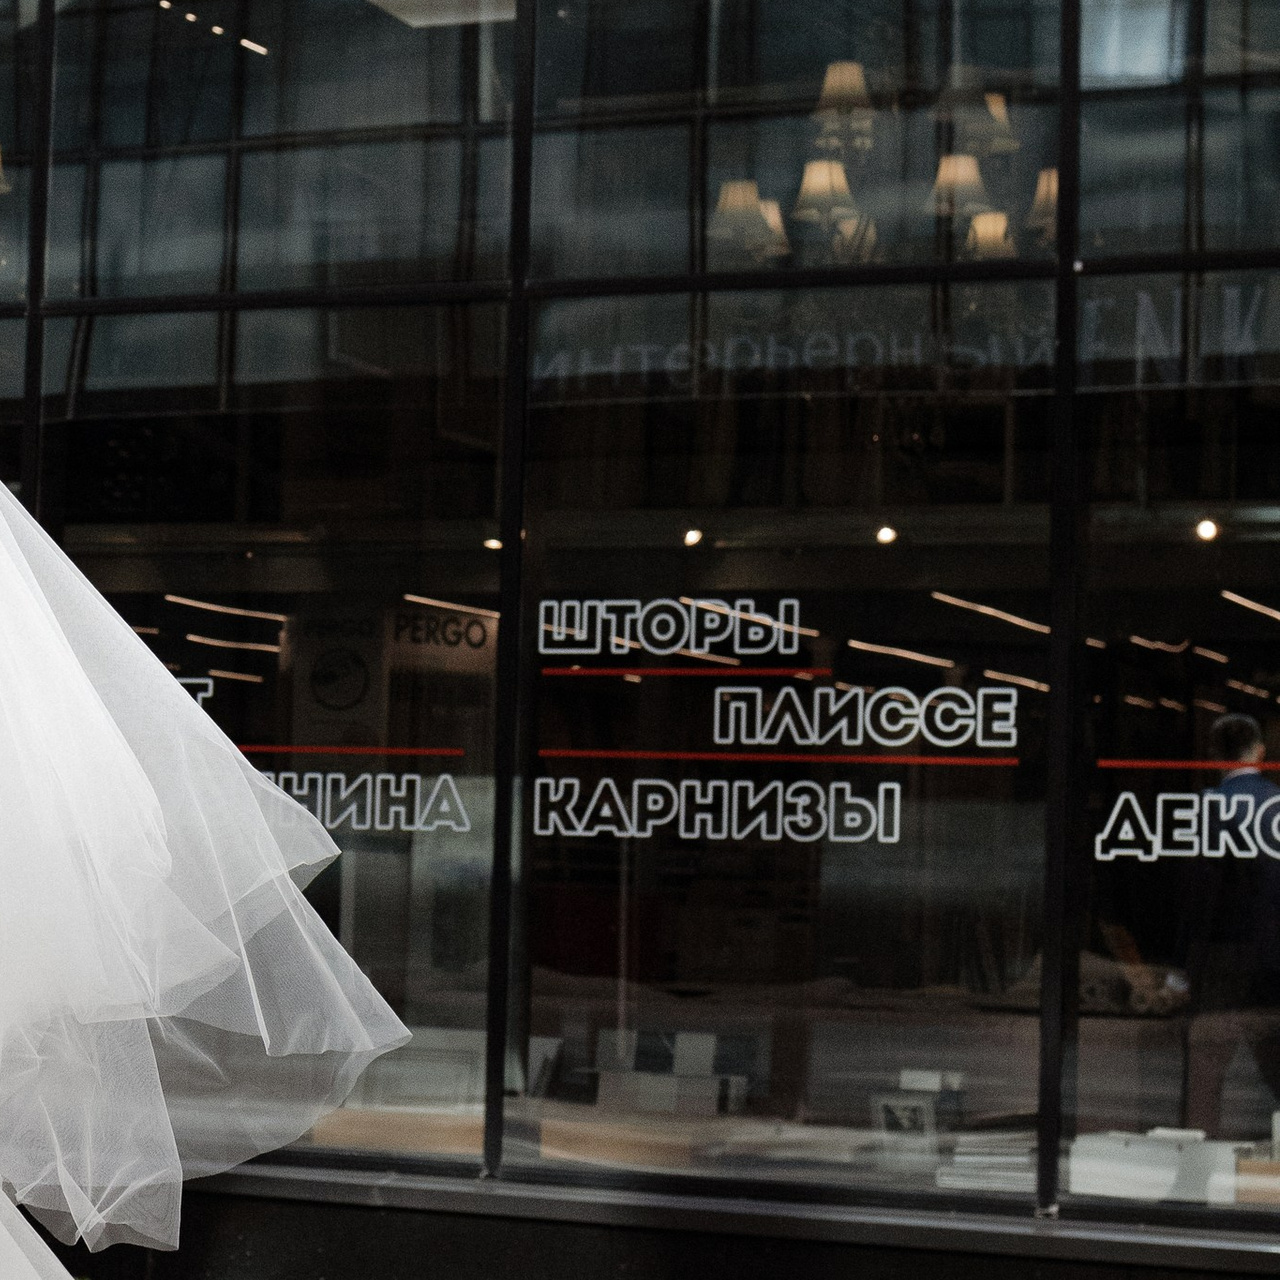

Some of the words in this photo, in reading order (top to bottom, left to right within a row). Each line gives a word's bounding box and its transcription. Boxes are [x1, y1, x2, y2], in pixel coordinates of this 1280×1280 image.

[394, 613, 488, 650] PERGO
[538, 598, 800, 655] ШТОРЫ
[714, 686, 1018, 749] ПЛИССЕ
[261, 771, 471, 832] НИНА
[533, 778, 902, 844] КАРНИЗЫ
